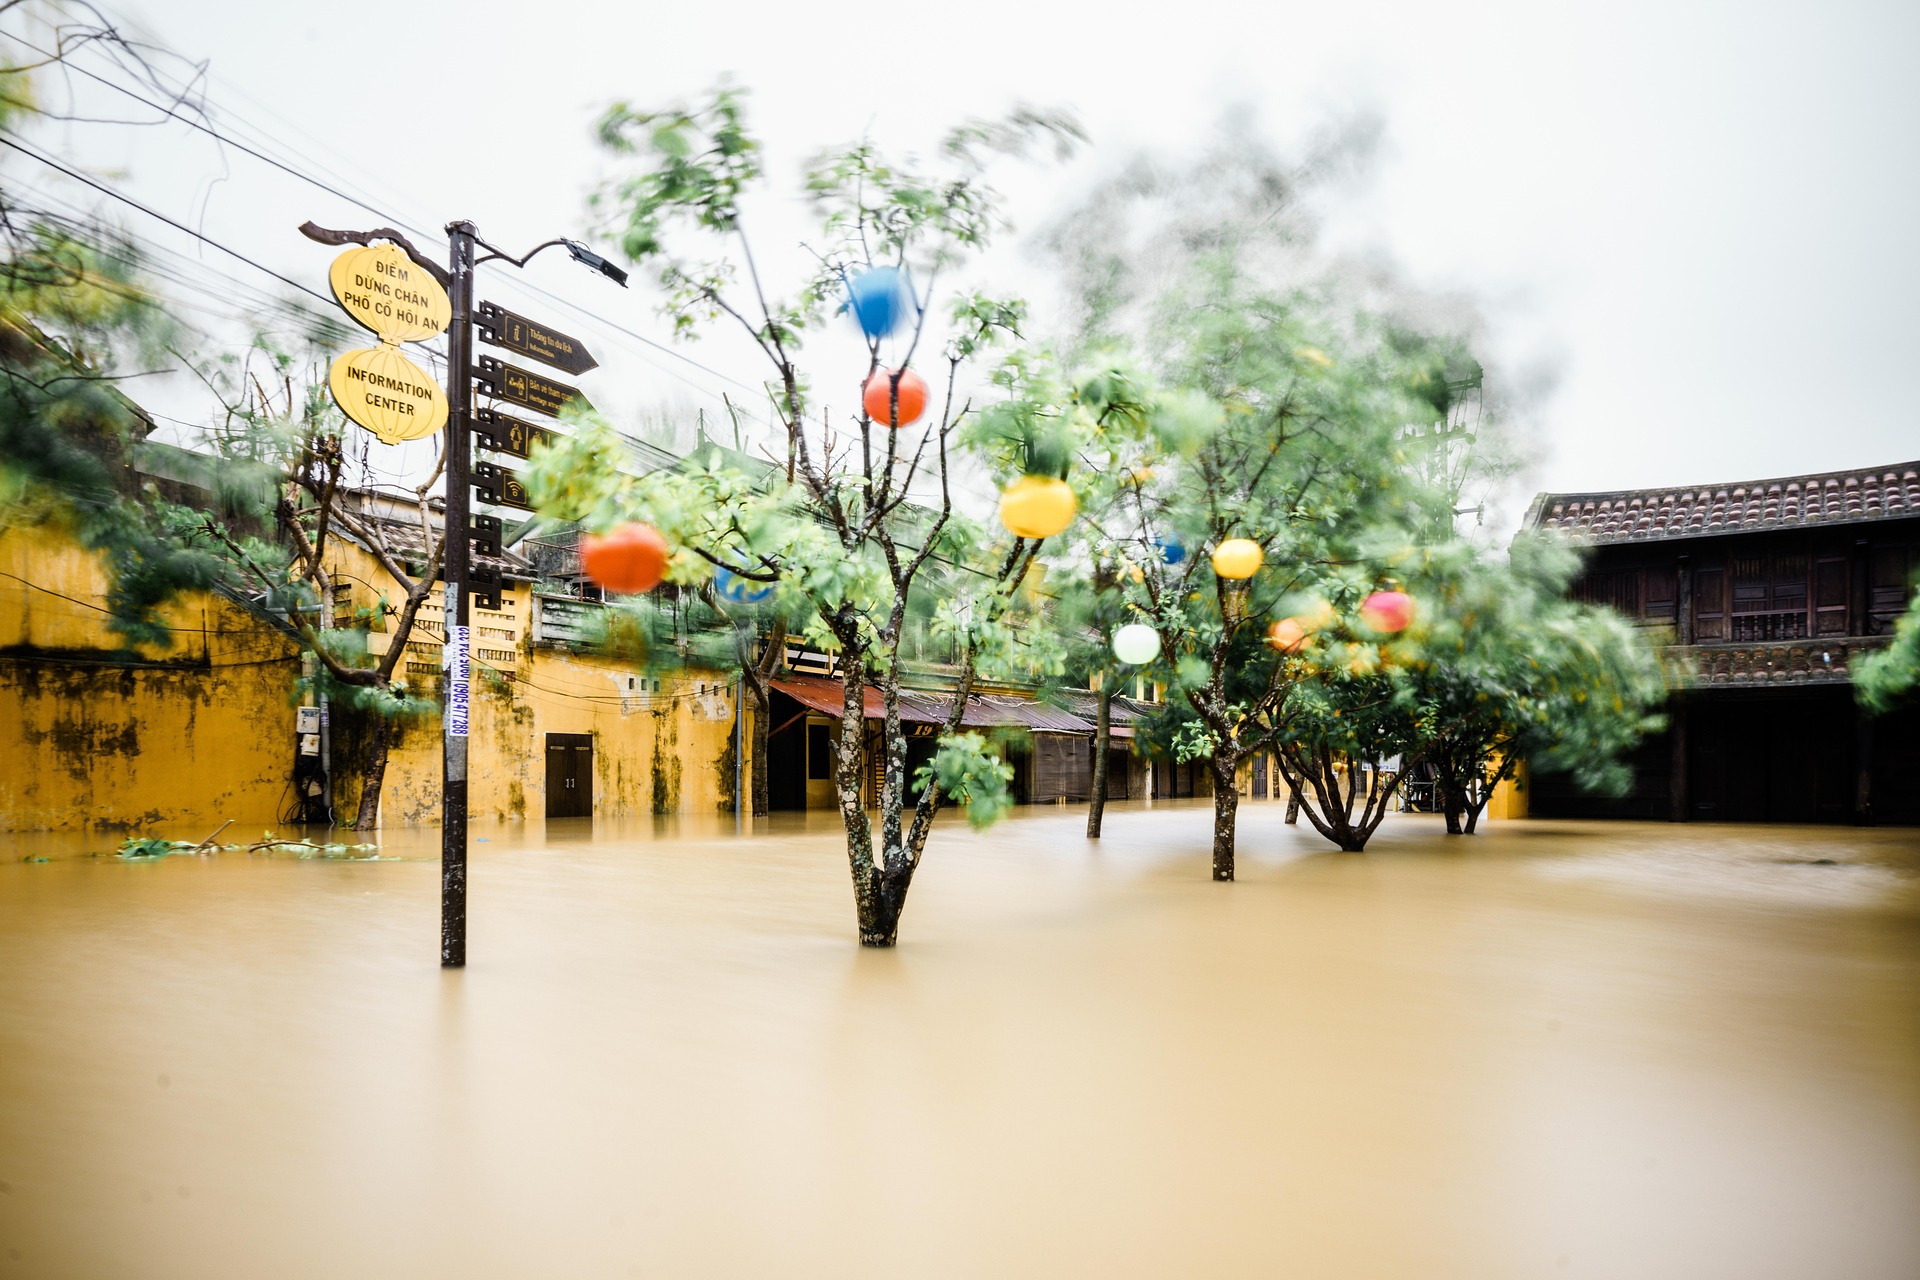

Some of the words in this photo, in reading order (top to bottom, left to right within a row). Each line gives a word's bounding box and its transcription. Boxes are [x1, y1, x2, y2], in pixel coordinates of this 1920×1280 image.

[376, 261, 408, 282] ĐIỂM
[355, 274, 390, 296] DỪNG
[395, 288, 428, 308] CHÂN
[344, 291, 370, 310] PHỐ
[375, 300, 392, 317] CỔ
[397, 309, 418, 326] HỘI
[422, 317, 439, 331] AN
[347, 366, 432, 401] INFORMATION
[365, 392, 415, 416] CENTER
[914, 725, 933, 736] 19
